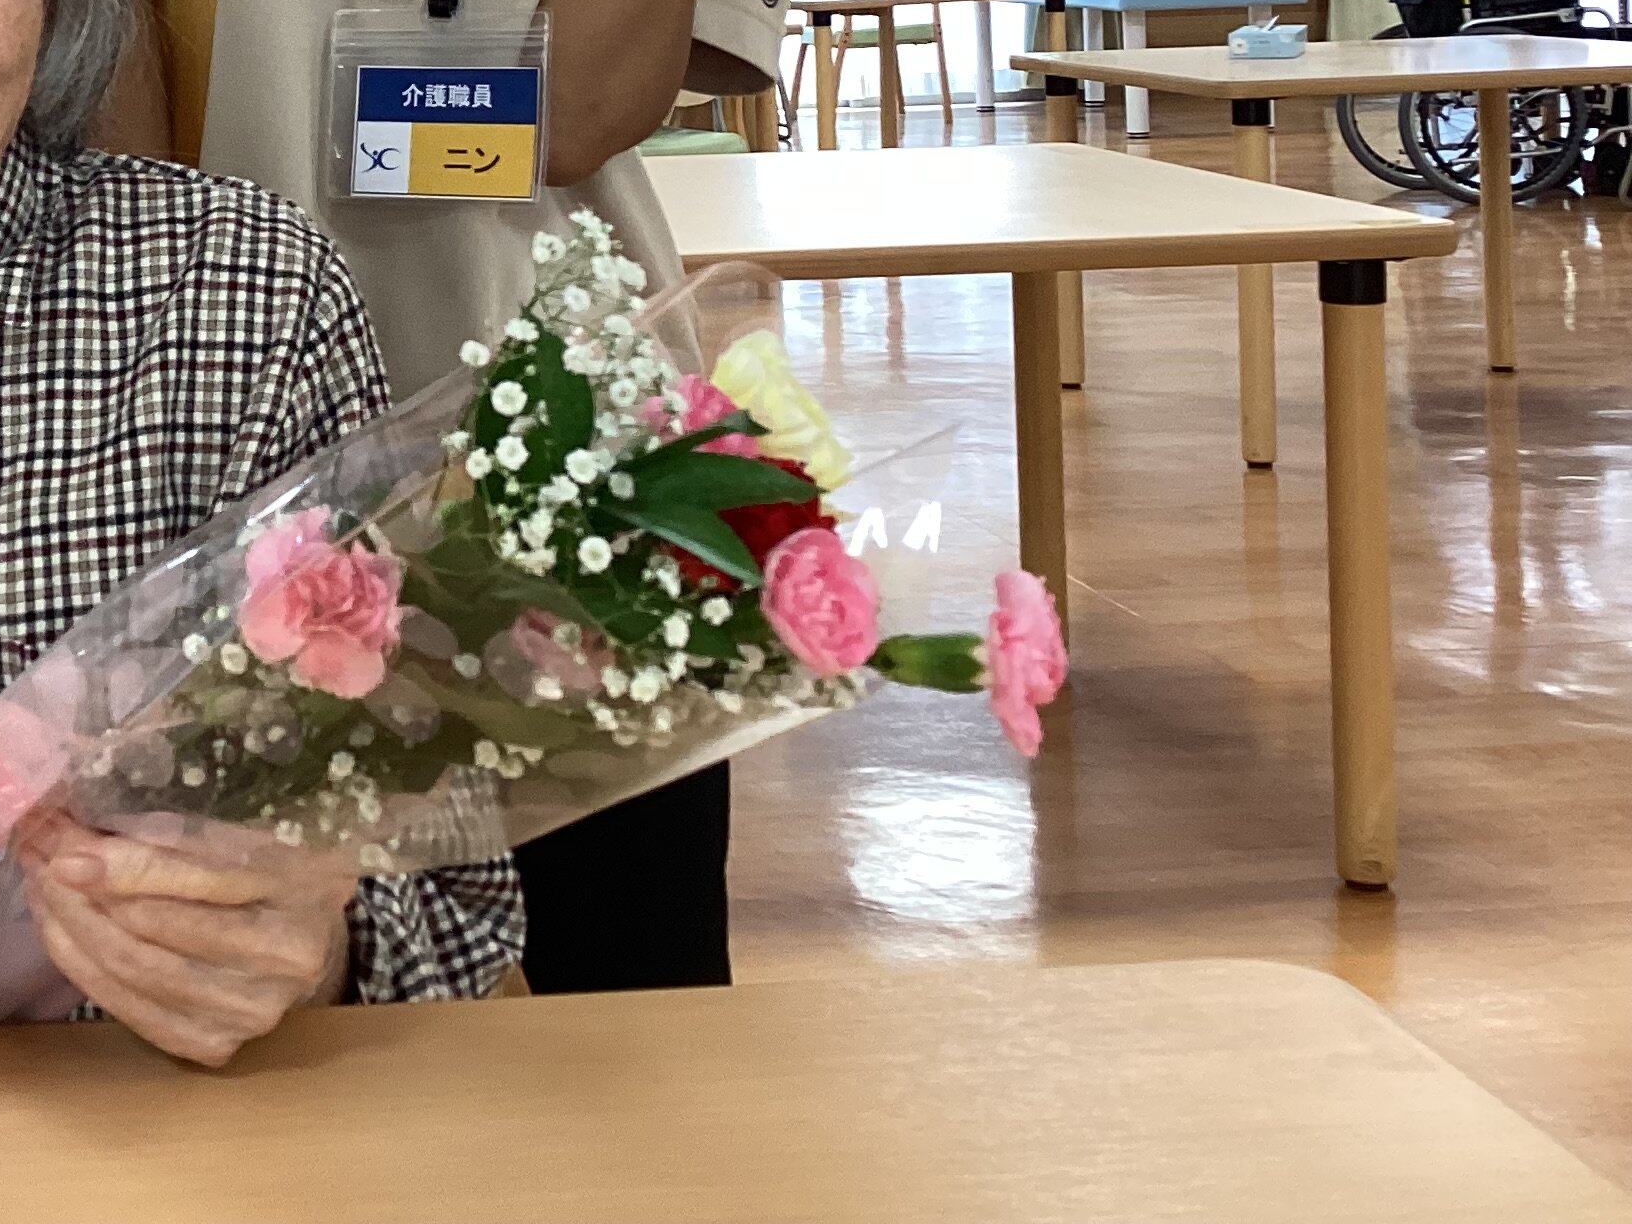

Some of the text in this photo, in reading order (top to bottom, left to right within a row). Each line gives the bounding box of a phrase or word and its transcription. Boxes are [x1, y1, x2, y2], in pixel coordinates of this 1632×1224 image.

[401, 83, 493, 108] 介護職員
[443, 147, 500, 173] ニン
